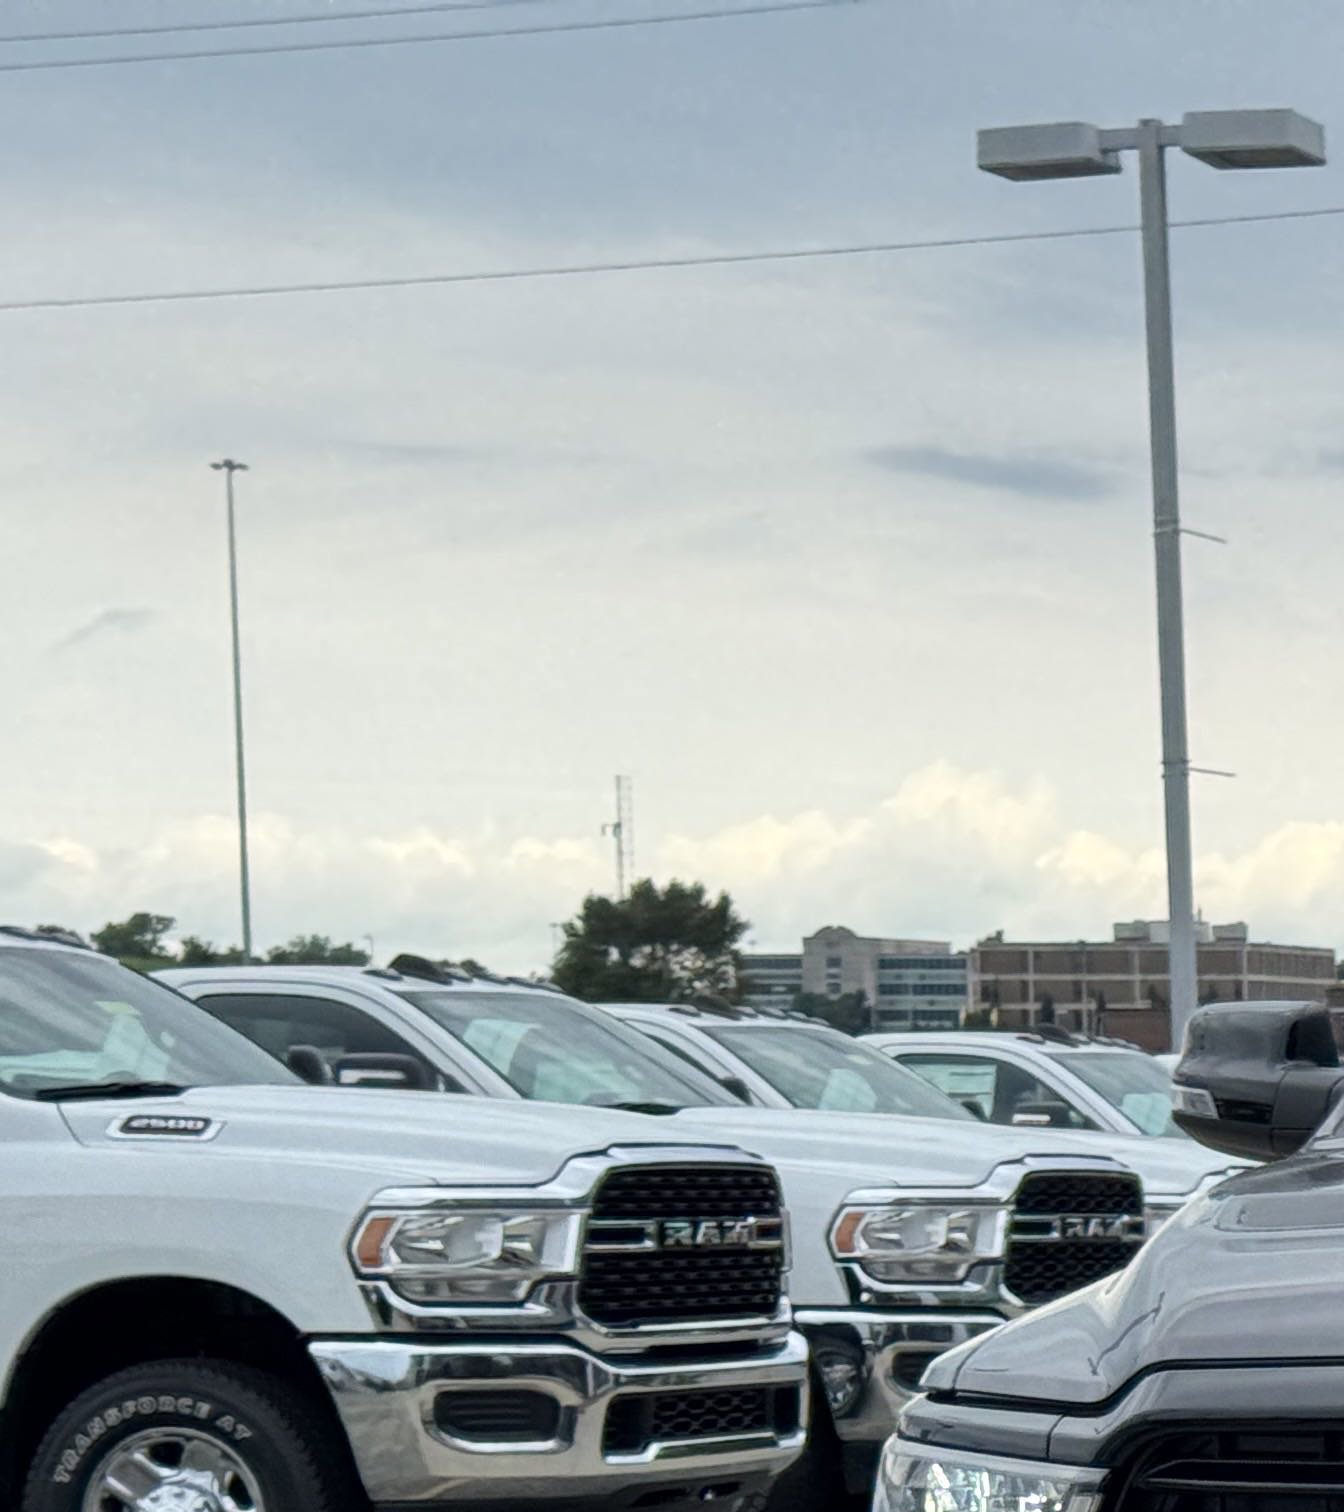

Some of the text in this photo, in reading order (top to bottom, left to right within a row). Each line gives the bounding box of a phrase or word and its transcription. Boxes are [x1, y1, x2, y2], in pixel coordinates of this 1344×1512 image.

[663, 1221, 755, 1246] RAM
[54, 1396, 253, 1483] TRANSFORCE AT
